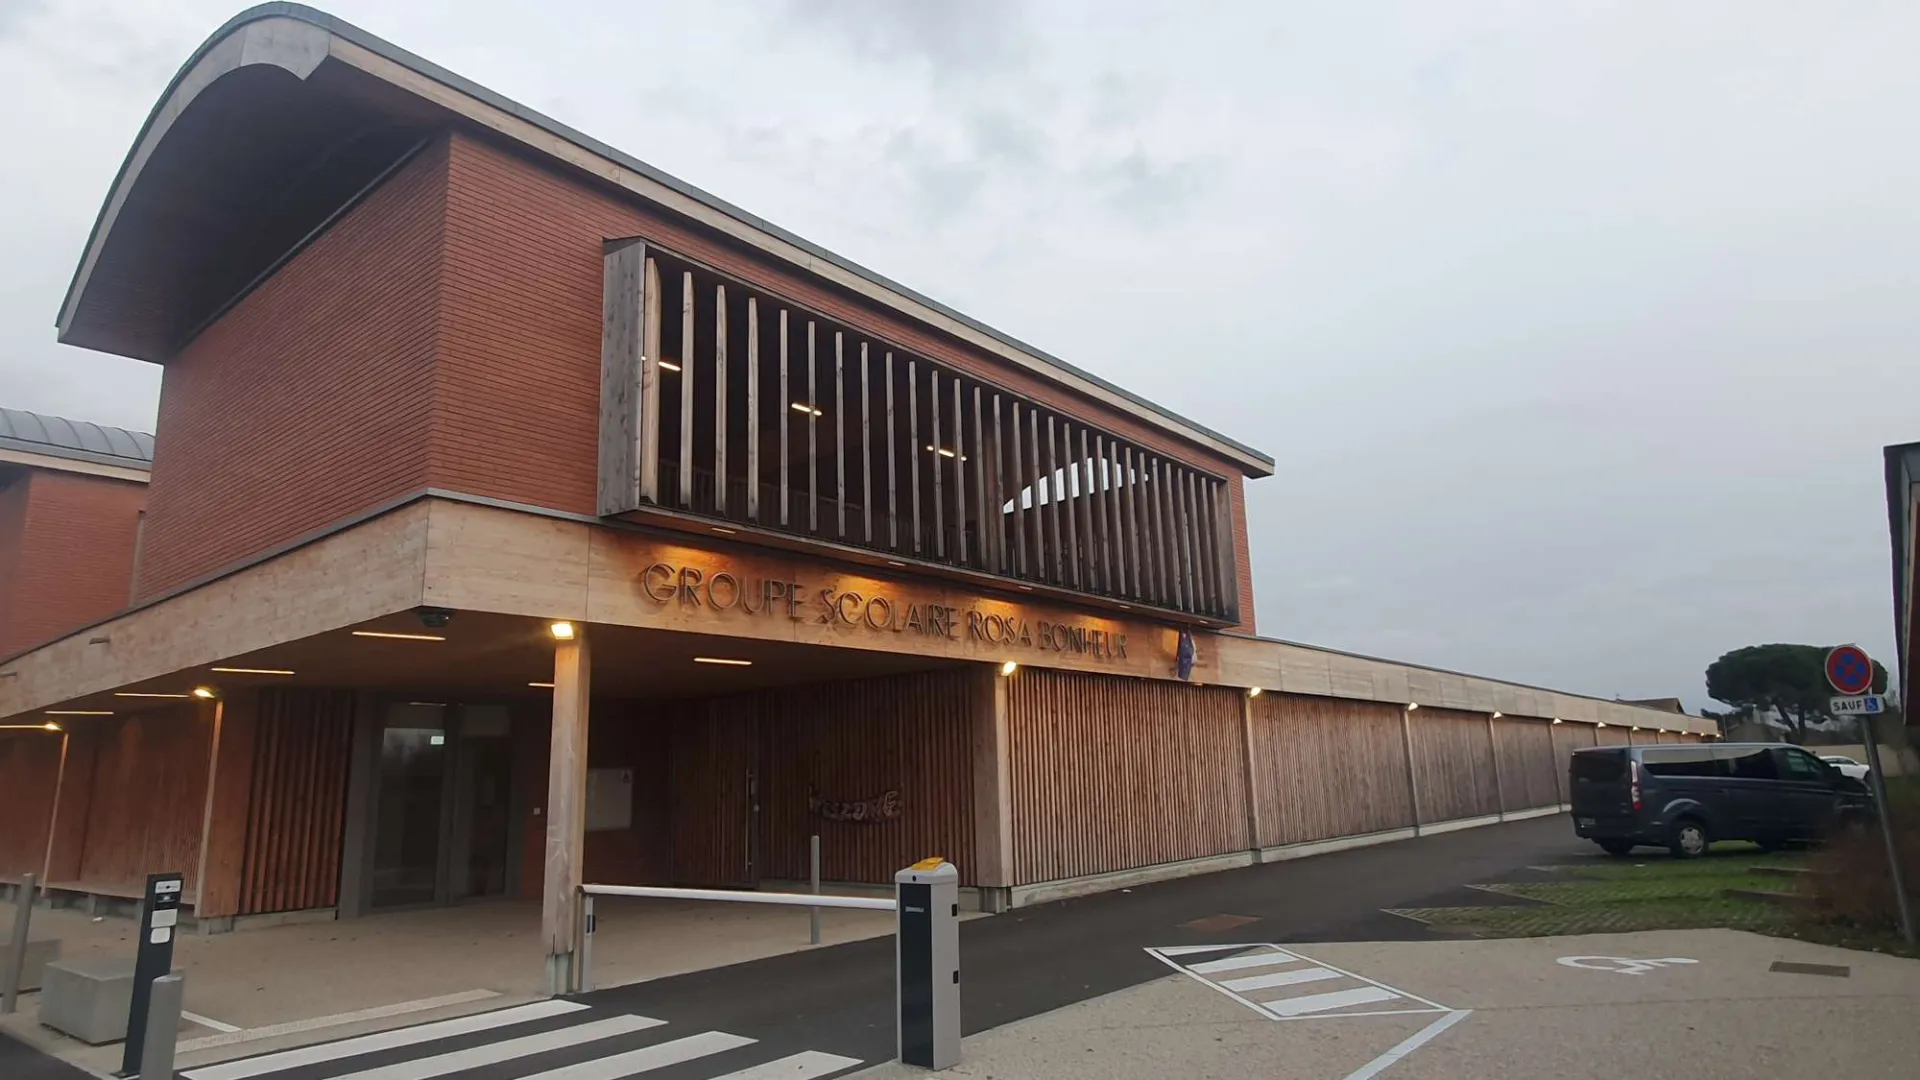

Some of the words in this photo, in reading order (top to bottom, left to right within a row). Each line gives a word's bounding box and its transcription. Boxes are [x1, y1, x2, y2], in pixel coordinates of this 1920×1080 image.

[643, 563, 802, 618] GROUPE
[817, 588, 958, 640] SCOLAIRE
[969, 609, 1032, 647] ROSA
[1038, 621, 1128, 660] BONHEUR
[1833, 700, 1862, 711] SAUF
